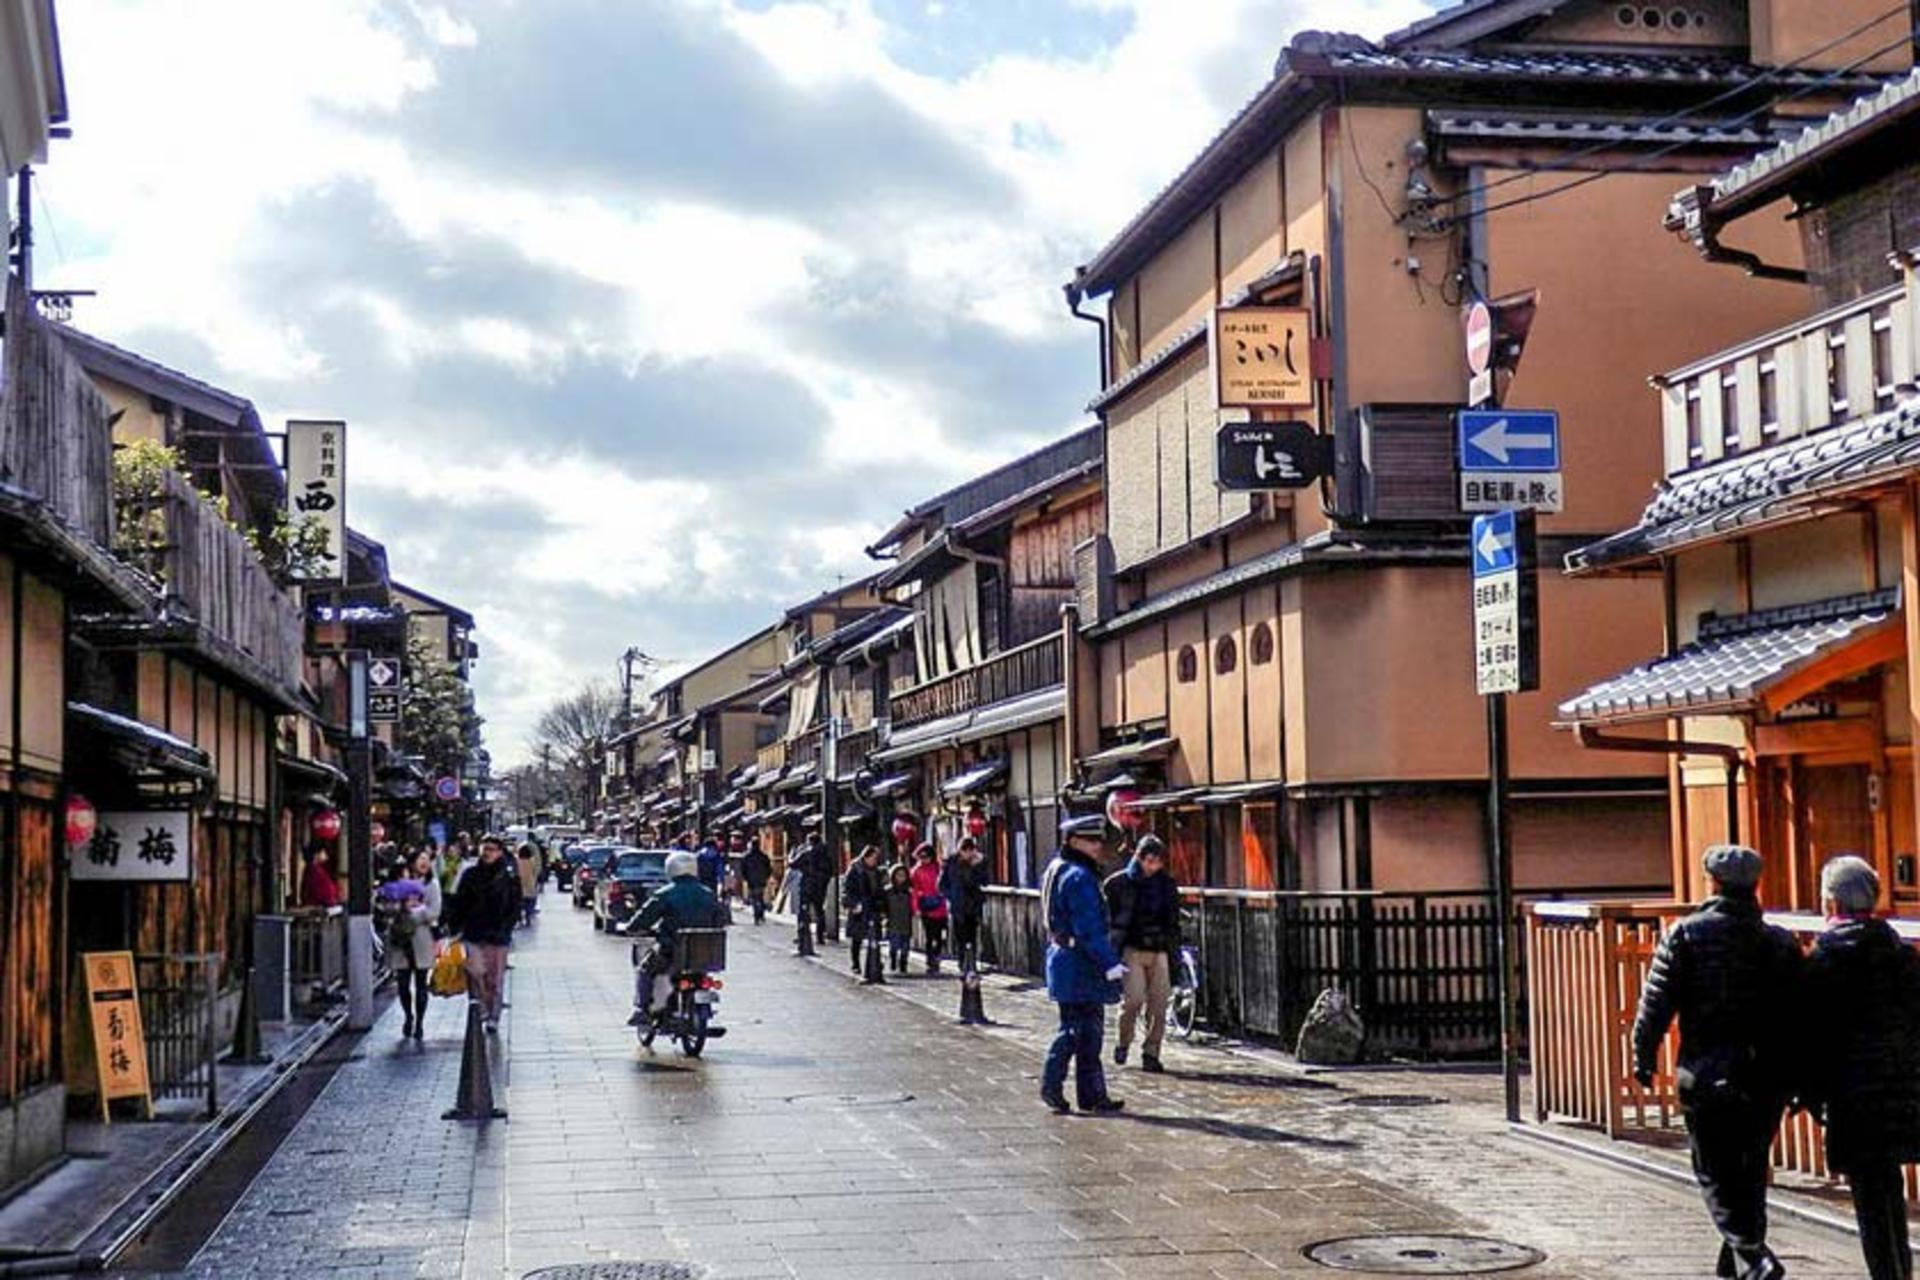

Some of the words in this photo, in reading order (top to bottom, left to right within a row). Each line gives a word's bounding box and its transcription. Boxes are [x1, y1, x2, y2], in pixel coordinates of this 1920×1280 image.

[1236, 327, 1297, 376] こいし
[321, 431, 335, 478] 京料理
[1465, 481, 1557, 503] 自転車を除く
